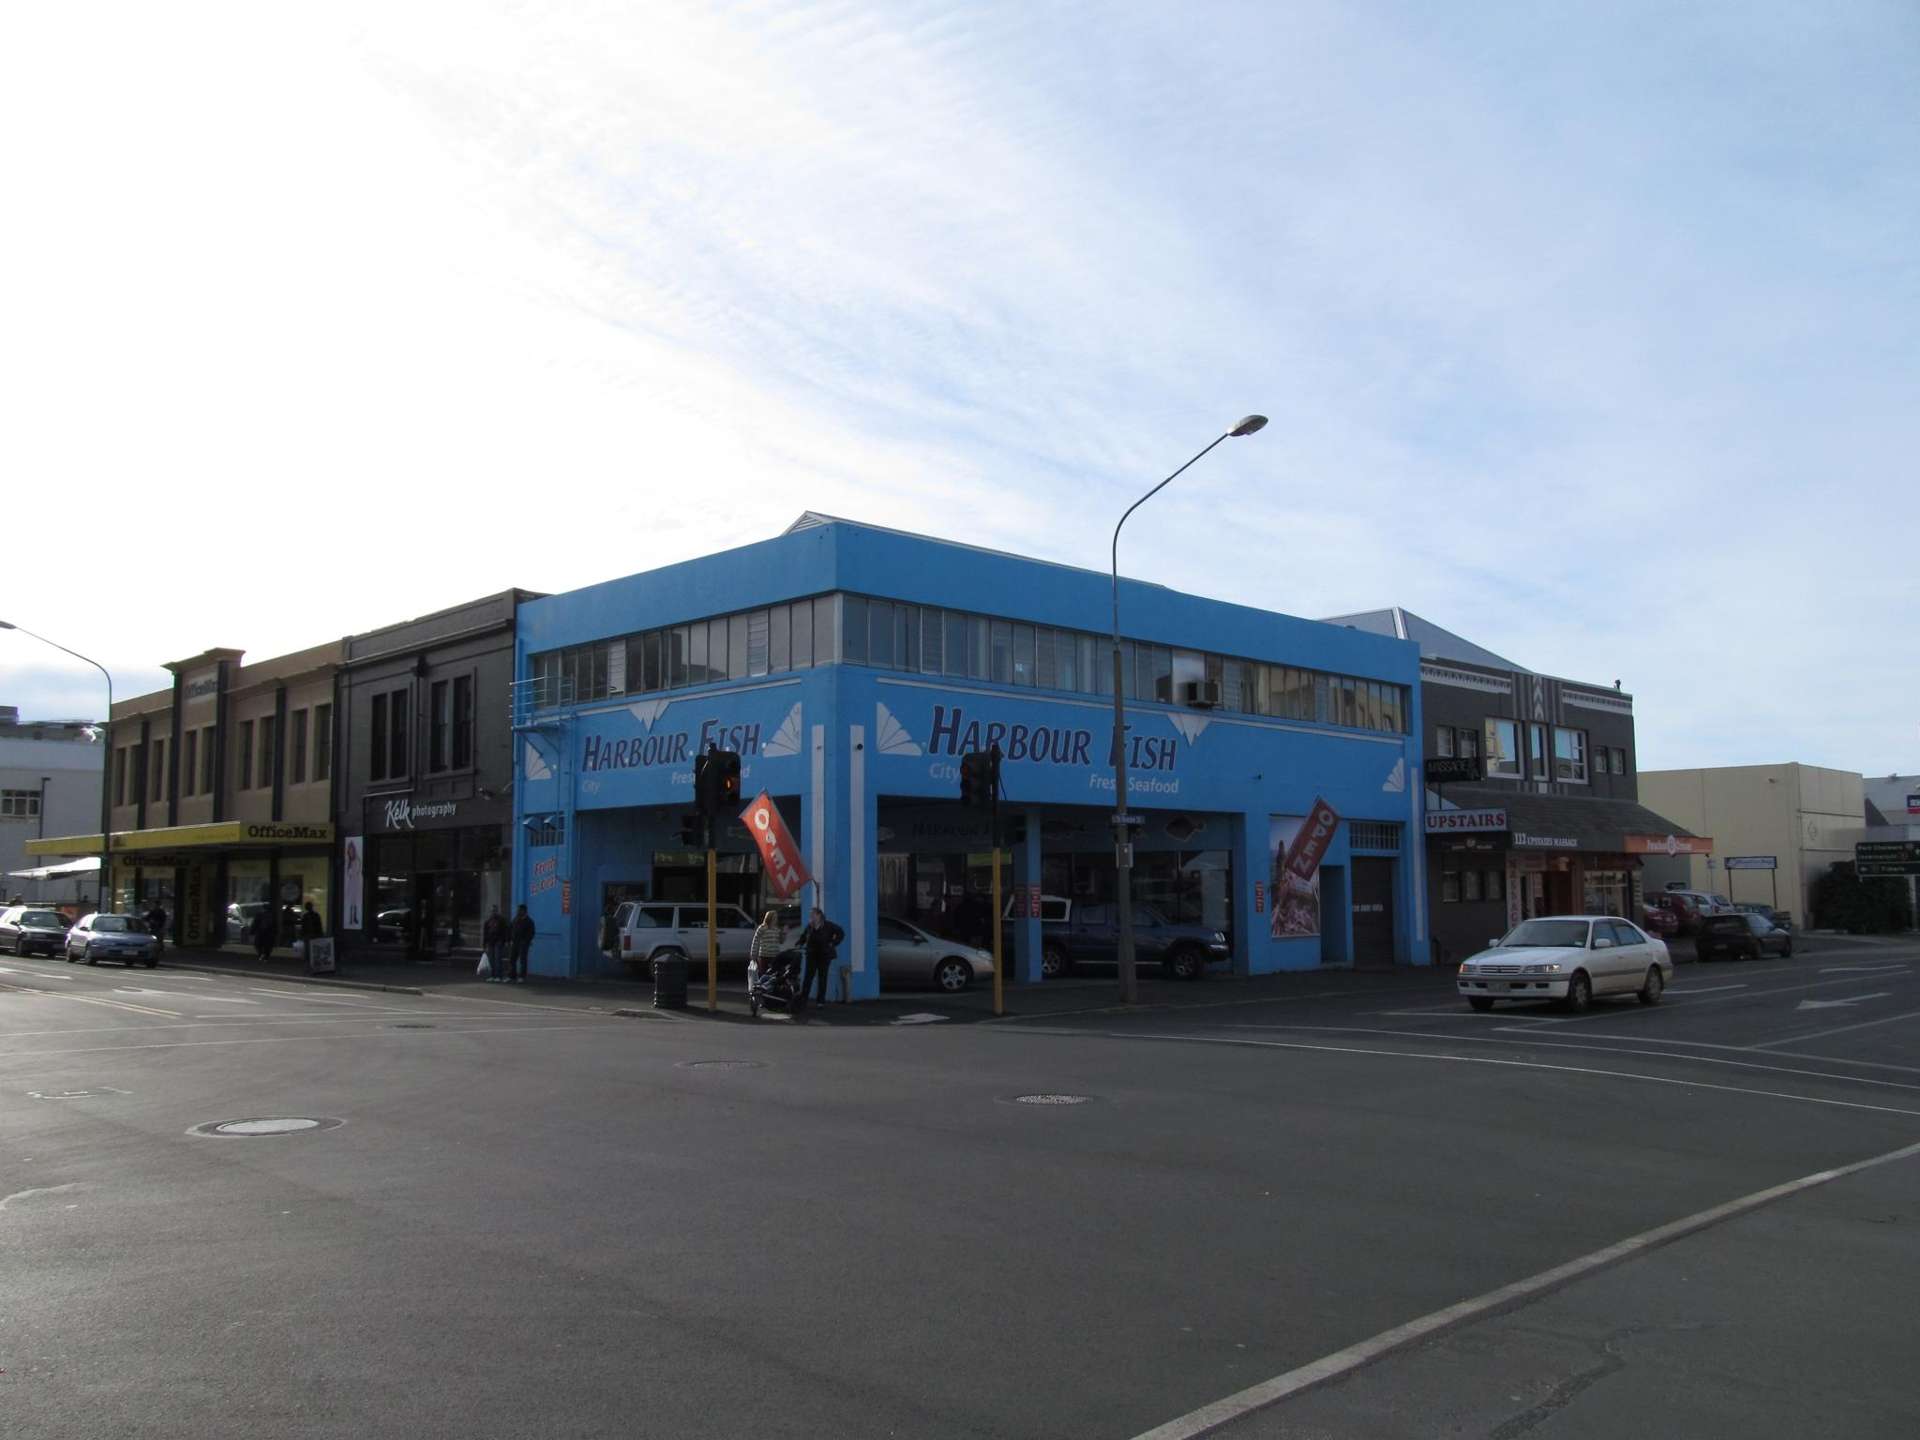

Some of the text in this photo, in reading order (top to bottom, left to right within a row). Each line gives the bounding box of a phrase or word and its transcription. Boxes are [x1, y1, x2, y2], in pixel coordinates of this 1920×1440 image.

[581, 732, 689, 772] HARBOUR
[929, 705, 1091, 765] HARBOUR
[1089, 774, 1180, 793] Fres Seafood
[384, 799, 457, 829] Kelk photography
[1426, 813, 1505, 828] UPSTAIRS
[247, 825, 328, 839] OfficeMax
[753, 808, 800, 891] OPEN
[1293, 810, 1335, 874] OPEN
